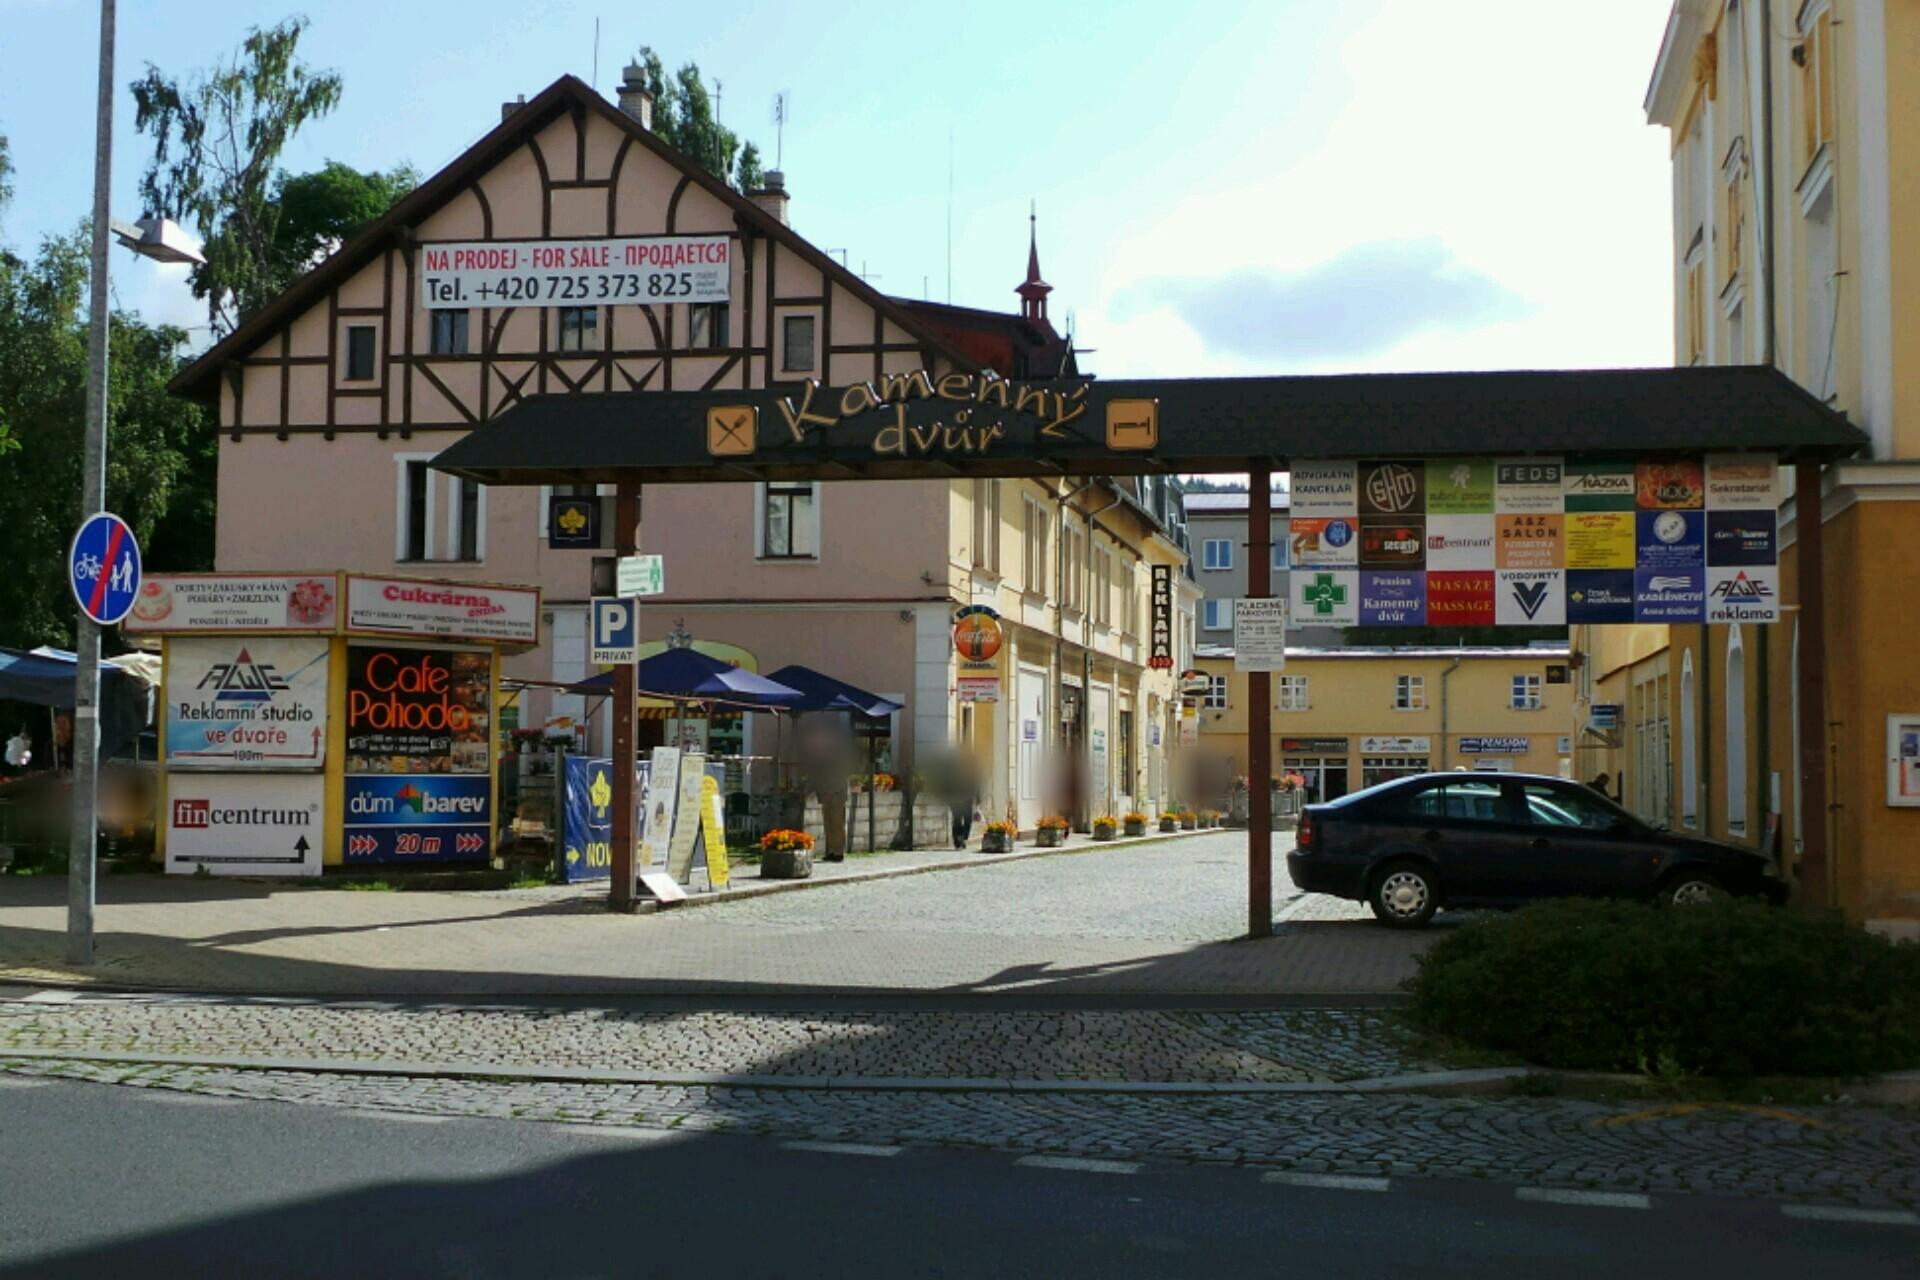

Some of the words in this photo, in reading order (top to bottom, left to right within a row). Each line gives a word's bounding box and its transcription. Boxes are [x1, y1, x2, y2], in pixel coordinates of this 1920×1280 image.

[426, 250, 449, 271] NA
[455, 249, 517, 271] PRODEJ
[532, 248, 565, 269] FOR
[570, 246, 609, 268] SALE
[625, 243, 727, 269] ПРОДАЕТСЯ
[426, 277, 468, 302] Tel.
[475, 276, 539, 300] +420
[546, 276, 589, 299] 725
[597, 274, 640, 298] 373
[648, 272, 692, 297] 825
[775, 371, 1089, 441] Kamenný
[873, 404, 1005, 456] dvůr
[1502, 467, 1557, 480] FEDS
[1428, 536, 1490, 549] fincentrum
[1503, 528, 1557, 538] SALON
[1429, 578, 1492, 591] MASÁŽE
[1500, 571, 1559, 580] VODOVRTY
[383, 584, 491, 608] Cukrárna
[1363, 598, 1420, 611] Kamenný
[1429, 600, 1492, 612] MASSAGE
[1154, 568, 1168, 657] REKLAMA
[1378, 611, 1405, 621] dvůr
[1710, 605, 1774, 619] reklama
[600, 604, 627, 644] P
[594, 651, 633, 661] PRIVAT
[366, 653, 450, 695] Cafe
[180, 703, 260, 722] Reklamní
[261, 702, 313, 722] studio
[350, 690, 470, 730] Pohoda
[206, 730, 227, 744] ve
[232, 726, 288, 744] dvoře
[1480, 737, 1529, 748] PENSION
[350, 791, 394, 813] dům
[421, 791, 486, 814] barev
[175, 802, 311, 826] fincentrum
[394, 833, 420, 854] 20
[586, 842, 612, 868] NOV
